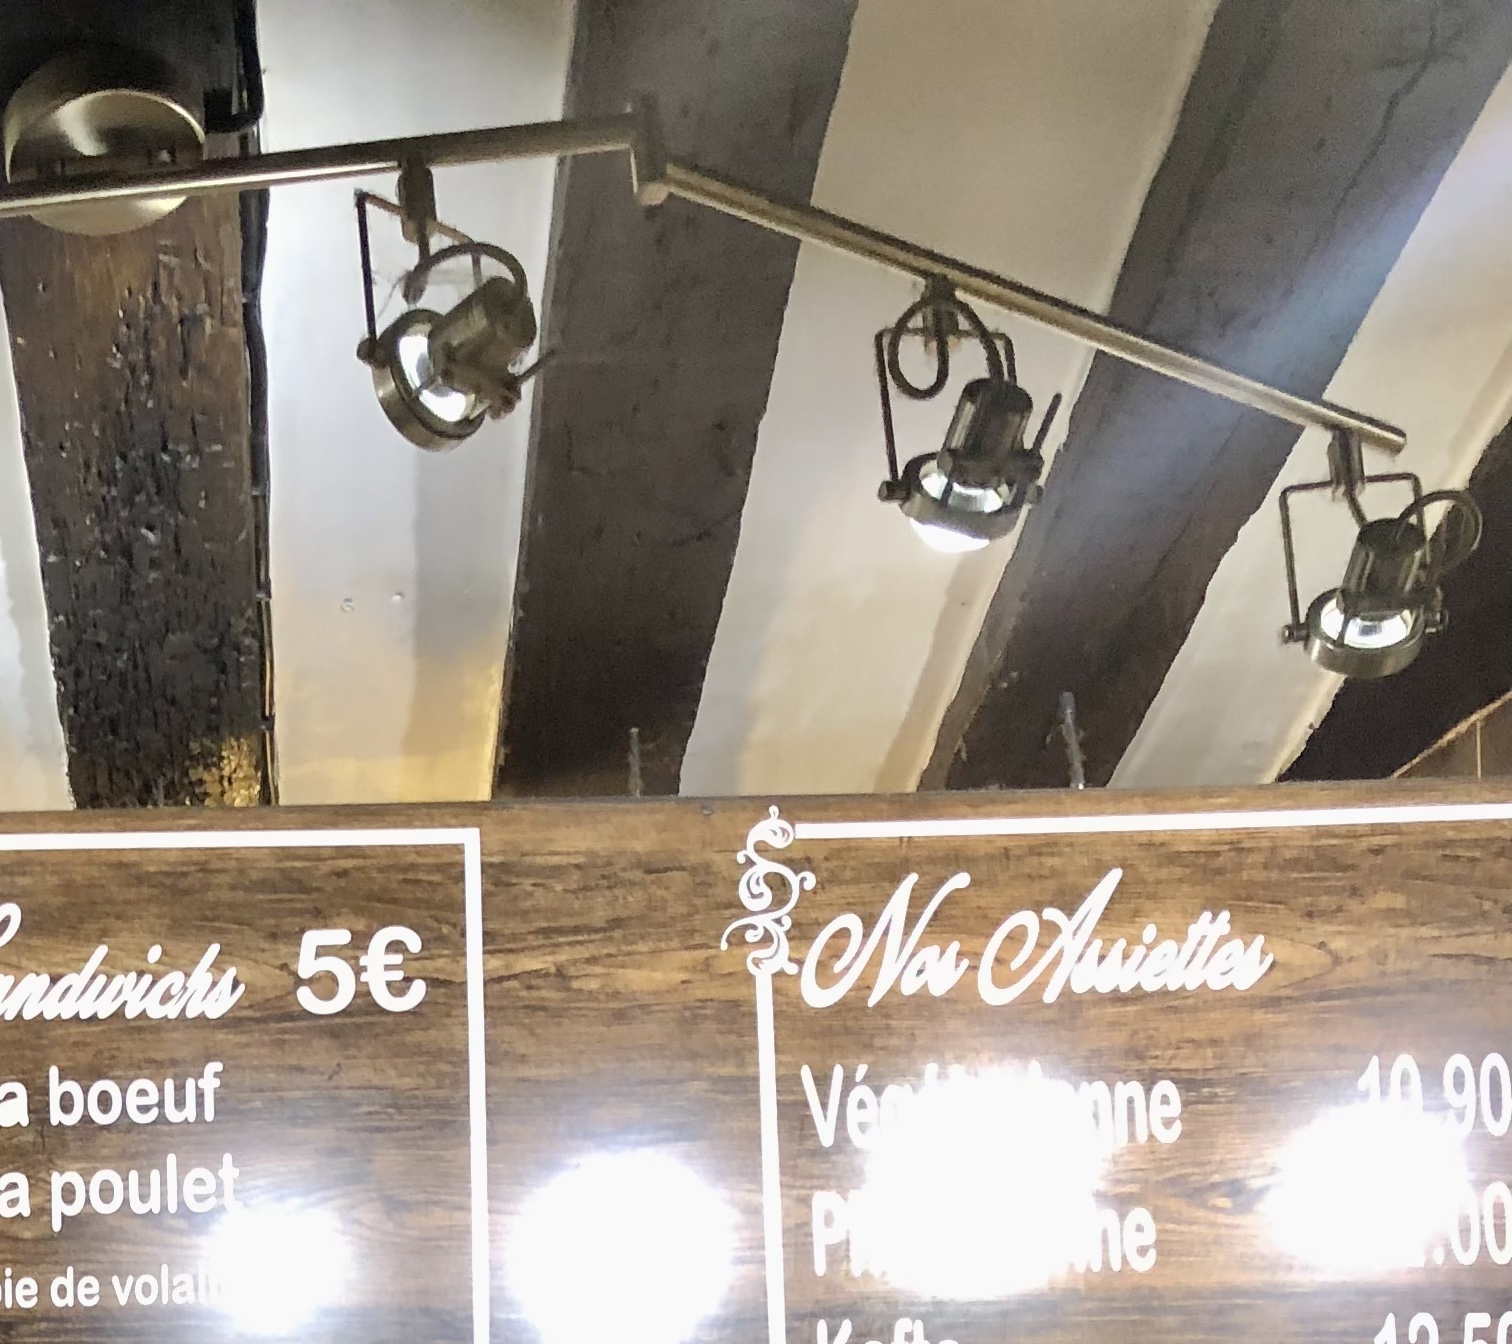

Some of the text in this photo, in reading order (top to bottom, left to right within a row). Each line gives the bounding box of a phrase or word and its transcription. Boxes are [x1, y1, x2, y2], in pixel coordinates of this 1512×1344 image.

[297, 926, 426, 1014] 5€
[800, 868, 1275, 1009] Nos Assiettes
[49, 1062, 223, 1125] boeuf
[1357, 1053, 1512, 1137] 1090
[50, 1153, 240, 1233] poulet
[51, 1266, 99, 1307] de
